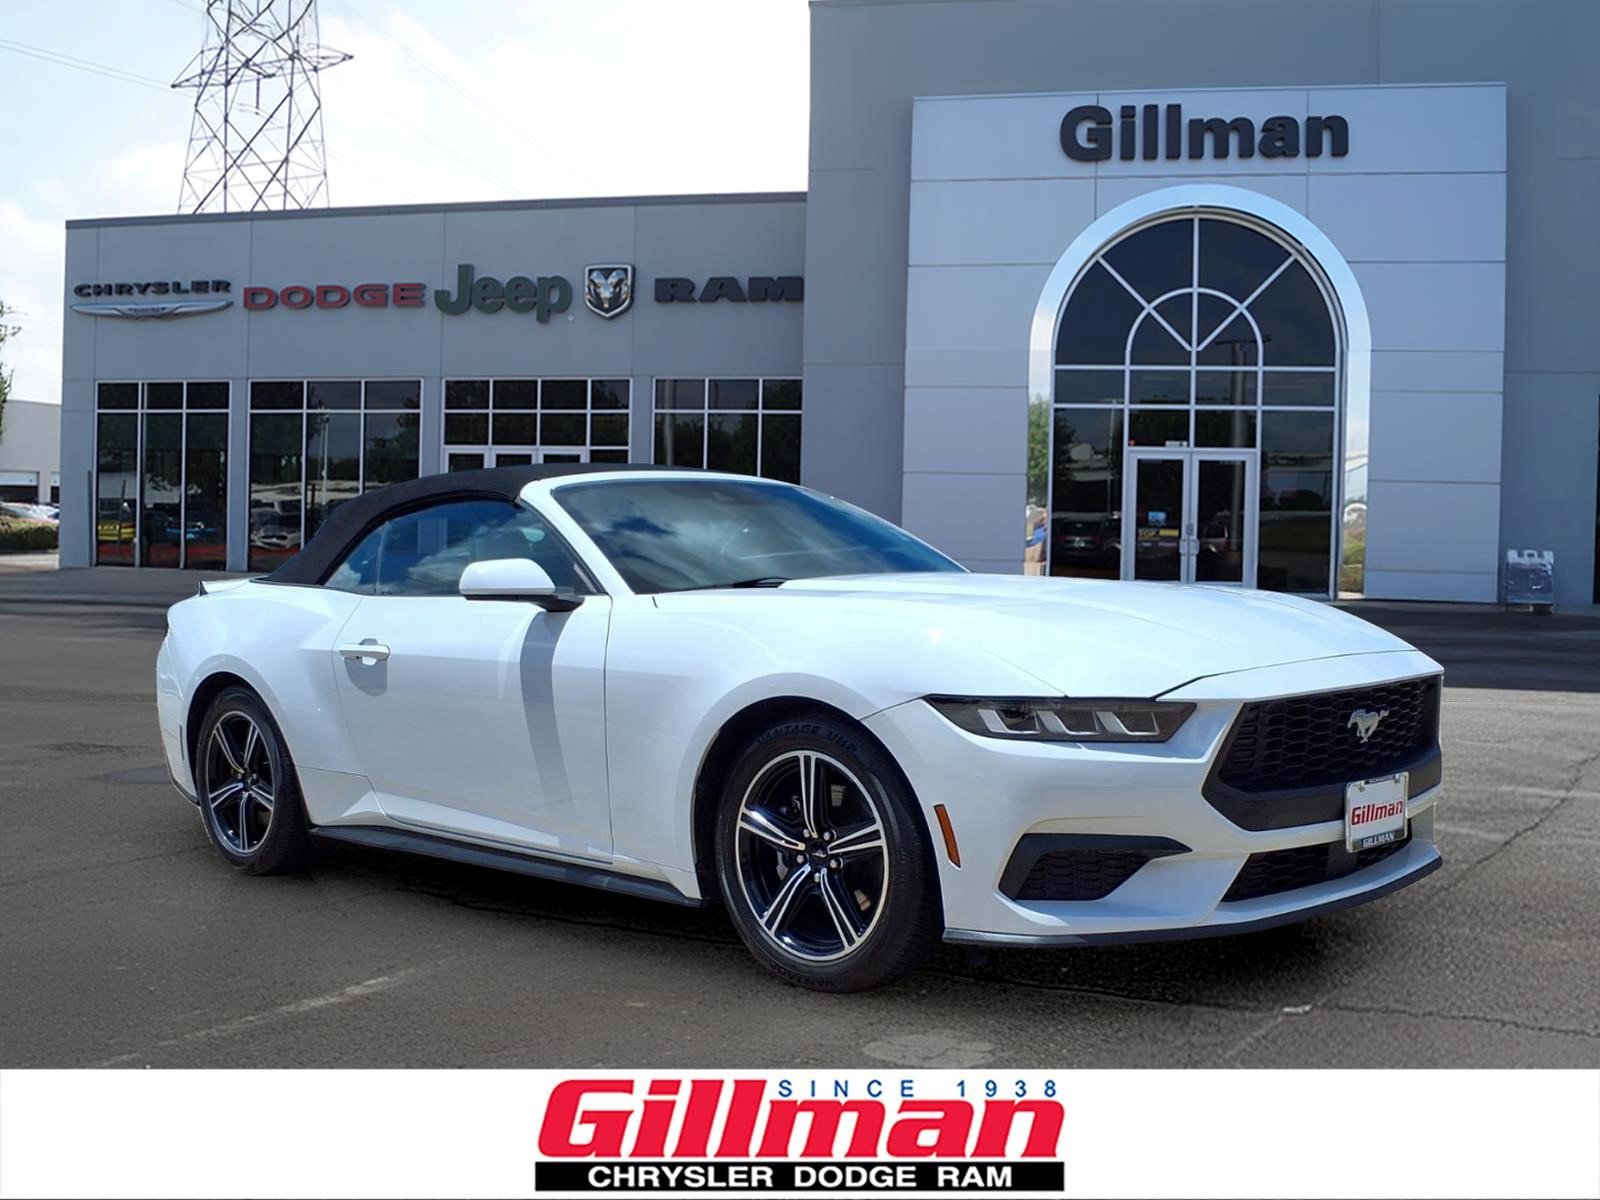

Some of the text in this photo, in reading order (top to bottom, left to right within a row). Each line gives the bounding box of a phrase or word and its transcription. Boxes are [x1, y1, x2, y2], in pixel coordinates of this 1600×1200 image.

[1060, 103, 1349, 162] Gillman
[74, 279, 232, 298] CHRYSLER
[243, 283, 426, 310] DODGE
[434, 264, 572, 324] Jeep
[654, 276, 804, 303] RAM
[758, 724, 822, 745] VANTAGE
[1351, 801, 1404, 826] Gillman
[1362, 832, 1395, 847] GILLMAN
